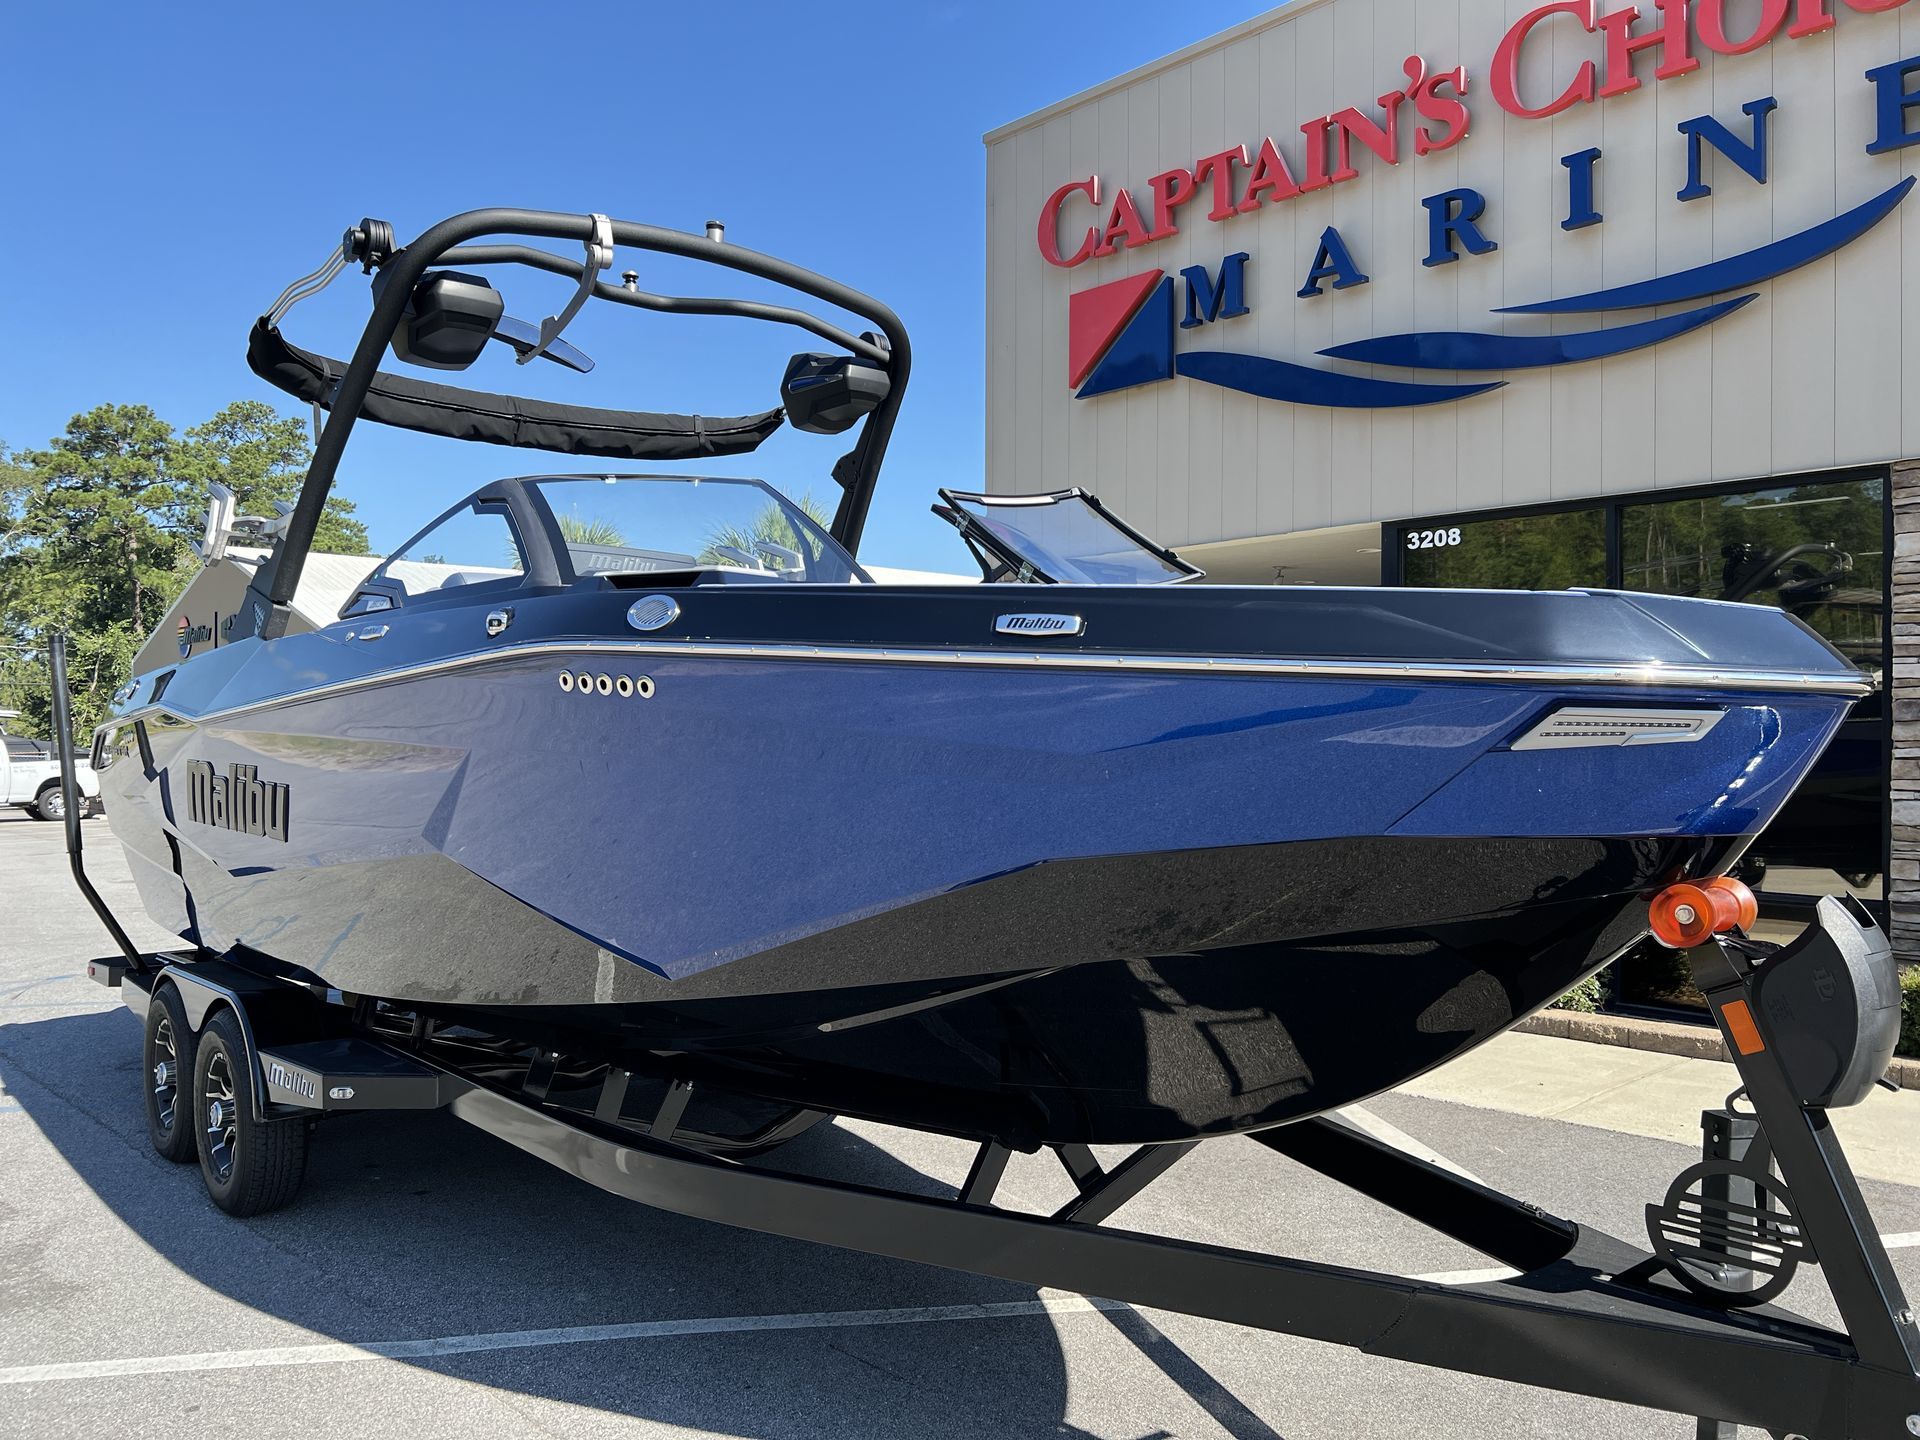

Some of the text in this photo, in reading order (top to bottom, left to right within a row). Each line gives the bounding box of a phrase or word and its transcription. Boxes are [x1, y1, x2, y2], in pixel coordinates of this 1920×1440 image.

[1407, 528, 1461, 549] 3208
[1006, 617, 1066, 629] Malibu
[187, 759, 290, 843] Malibu
[269, 1062, 315, 1098] Malibu
